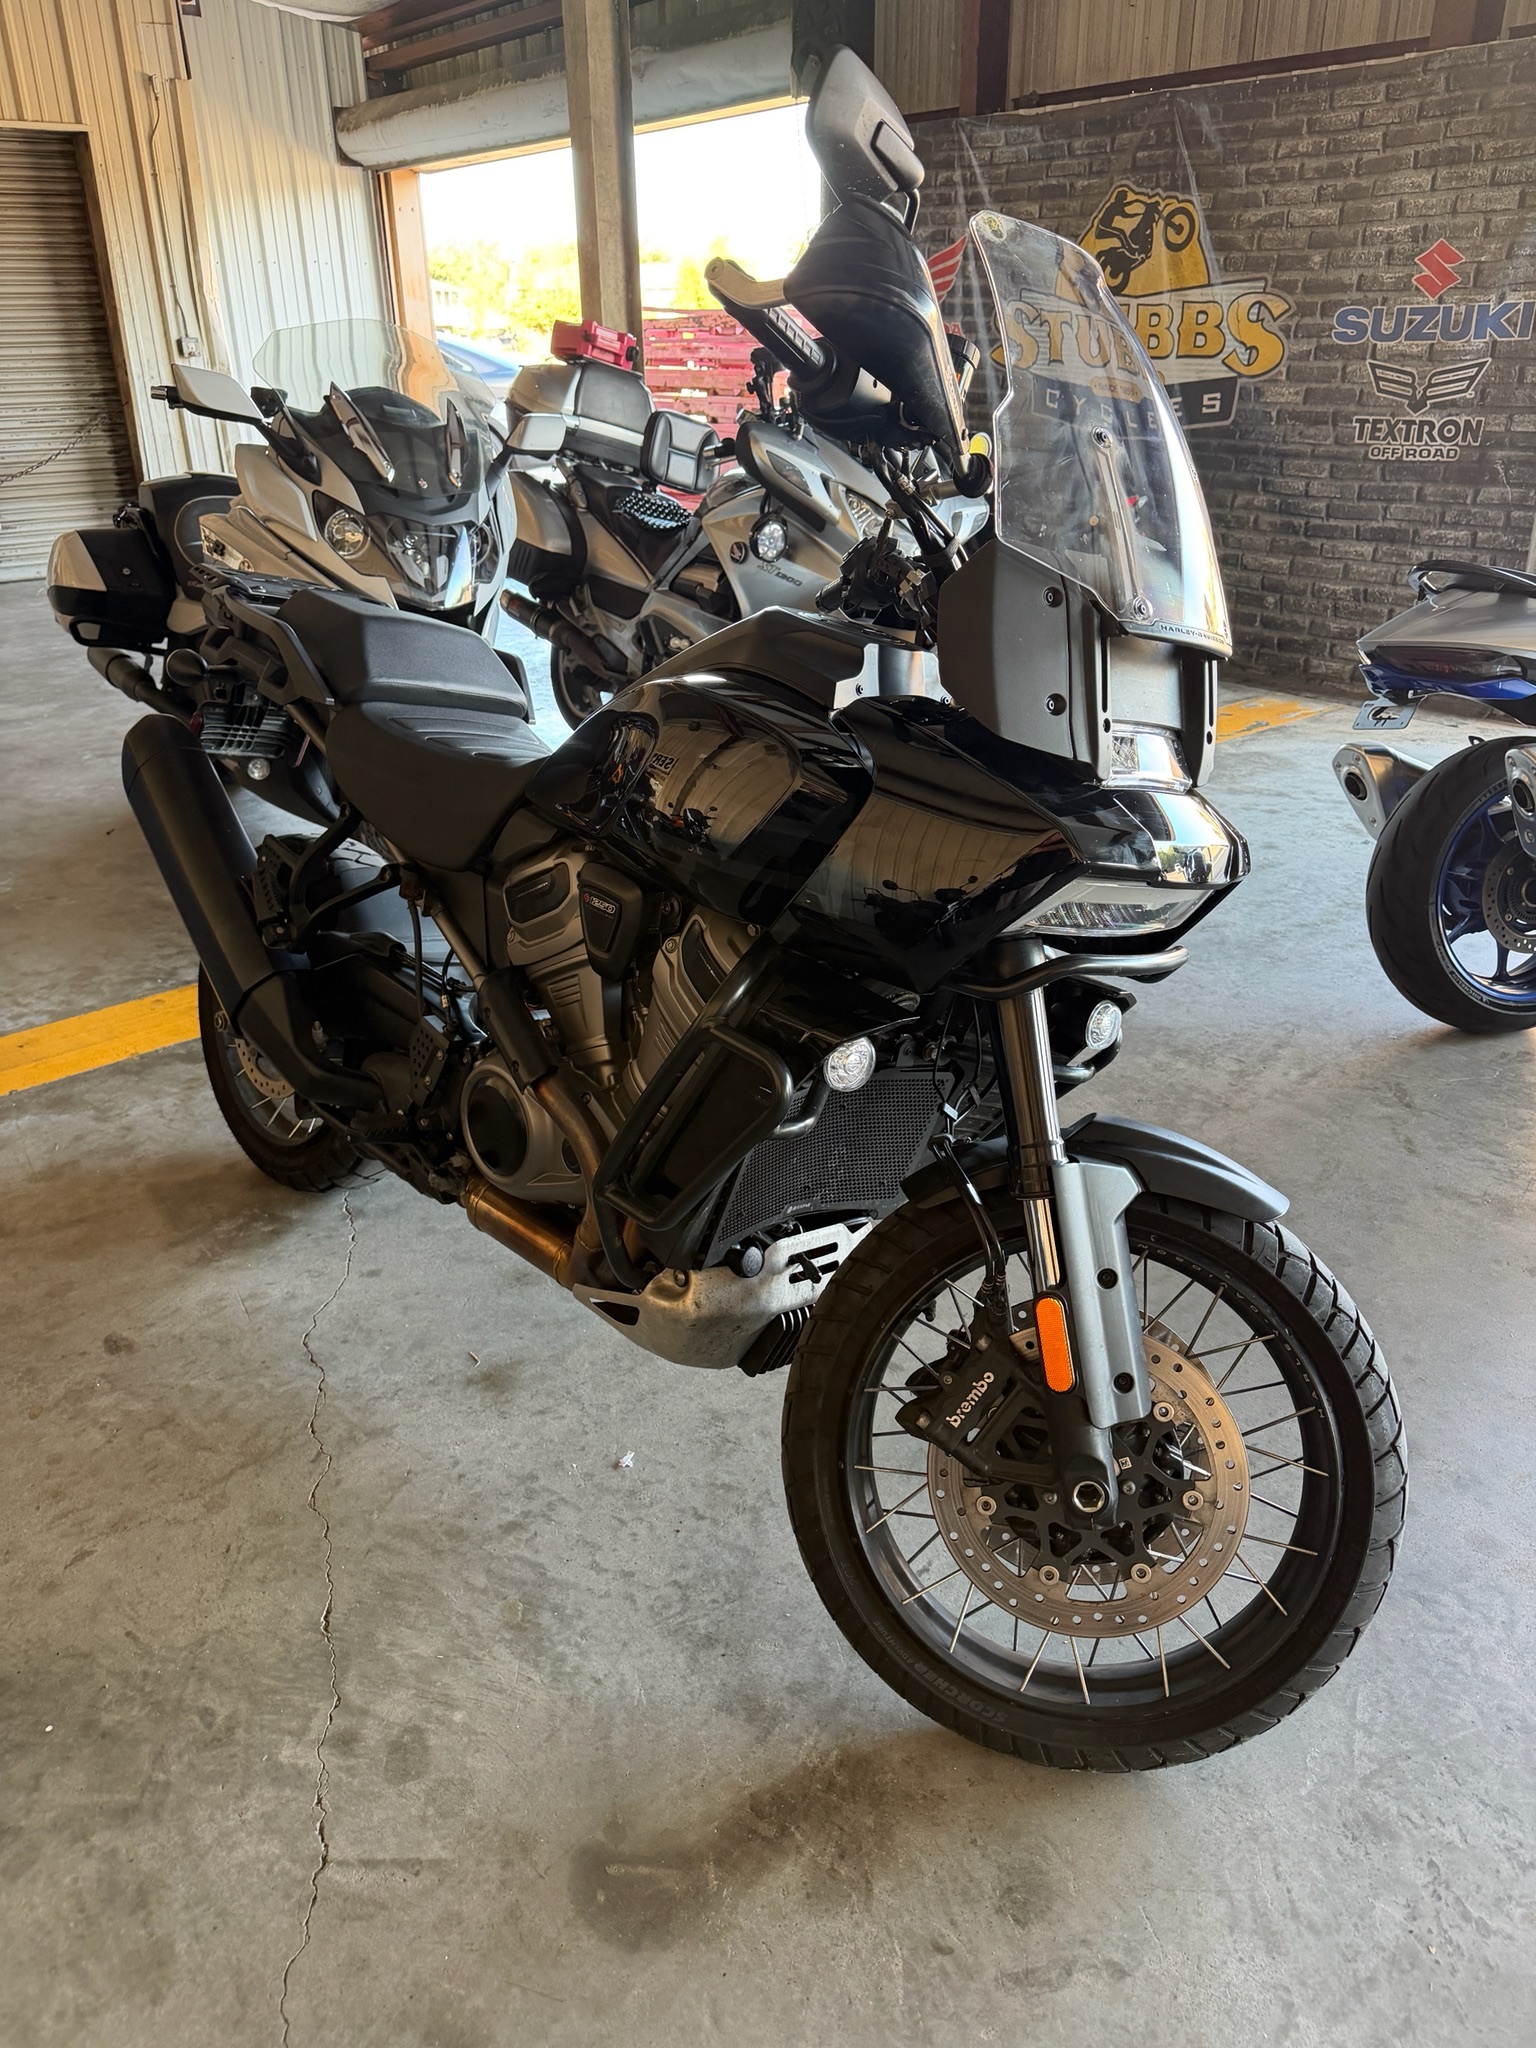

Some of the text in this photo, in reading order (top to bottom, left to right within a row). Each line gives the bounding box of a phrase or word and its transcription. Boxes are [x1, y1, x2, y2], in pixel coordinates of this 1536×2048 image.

[990, 292, 1292, 377] STUBBS
[1332, 301, 1535, 345] SUZUKI
[1046, 388, 1222, 430] CYCLES
[1353, 416, 1485, 446] TEXTRON
[1369, 446, 1460, 462] OFF ROAD
[945, 1371, 995, 1429] brembo
